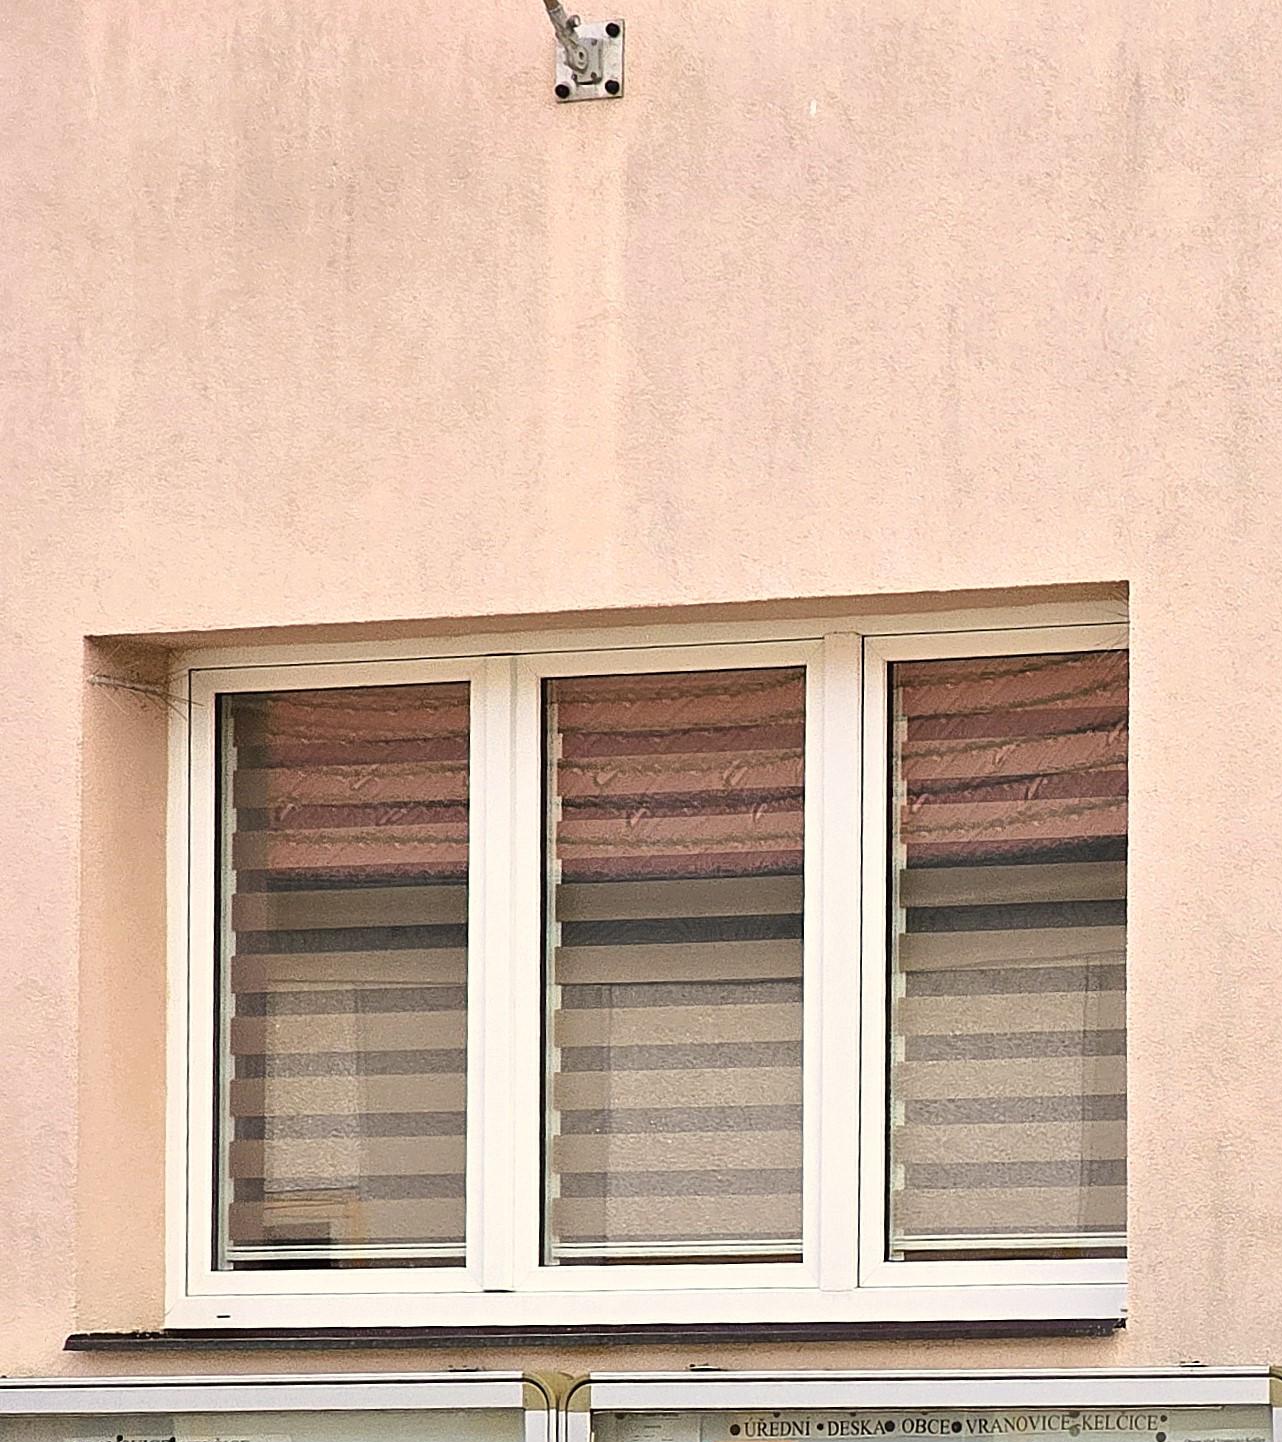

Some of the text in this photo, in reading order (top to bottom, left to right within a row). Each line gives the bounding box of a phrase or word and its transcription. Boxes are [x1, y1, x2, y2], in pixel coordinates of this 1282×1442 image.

[744, 1416, 810, 1437] ÚŘEDNÍ
[828, 1420, 886, 1436] DESKA
[902, 1419, 950, 1434] OBCE
